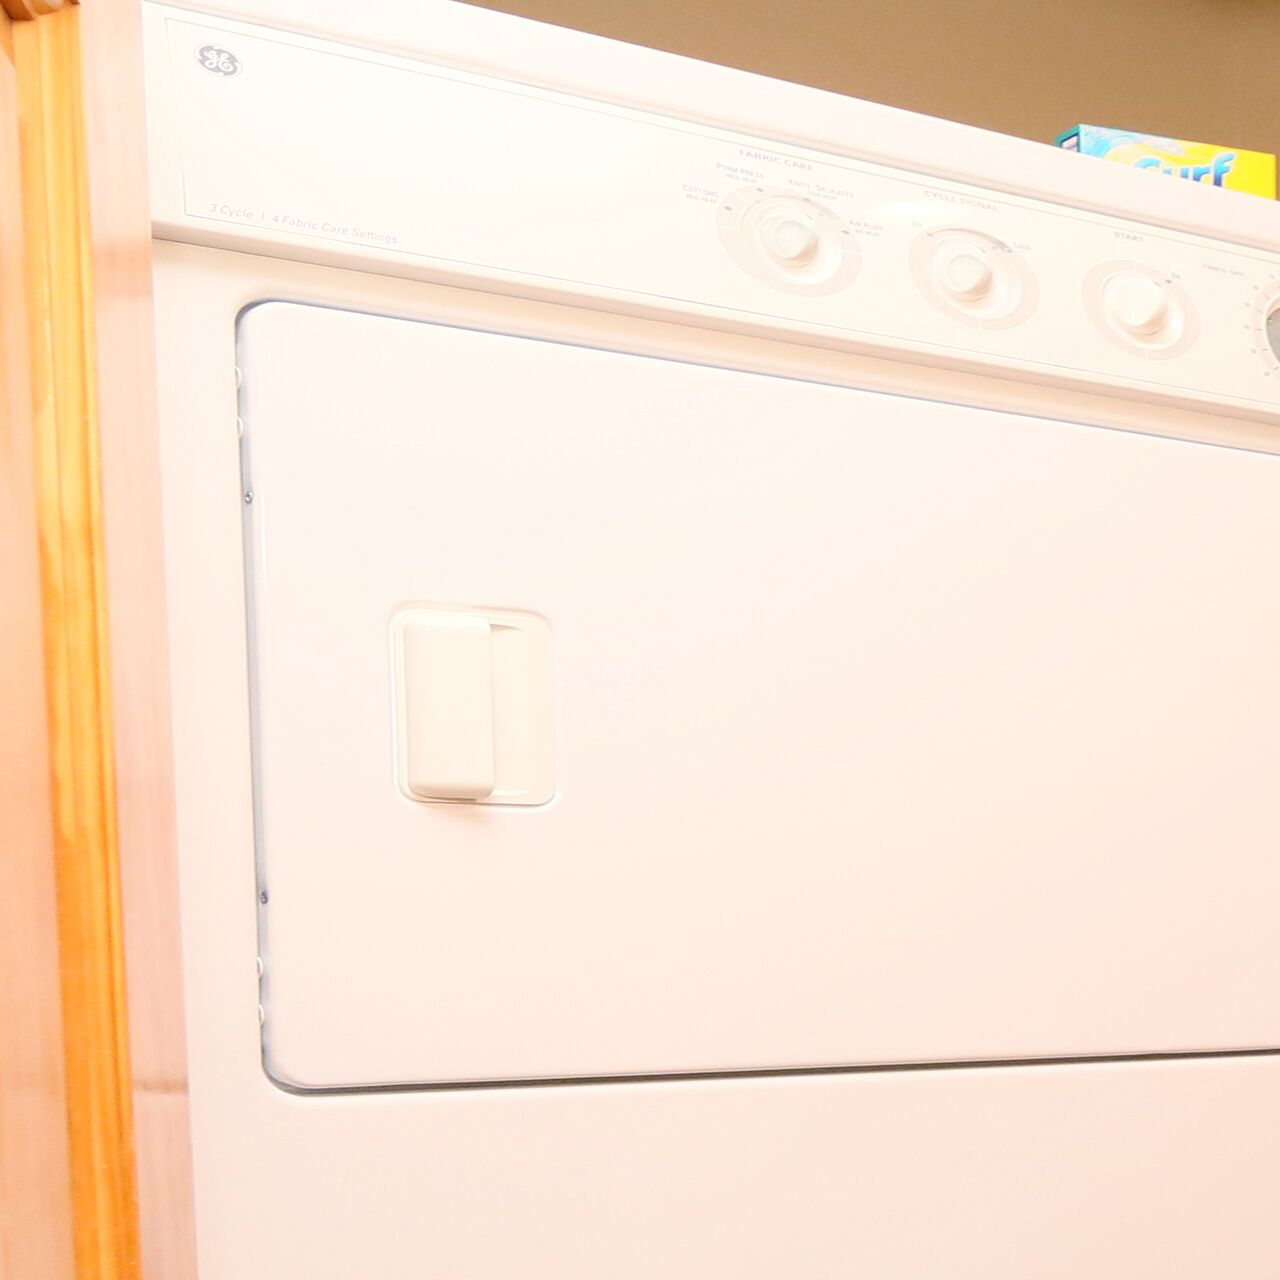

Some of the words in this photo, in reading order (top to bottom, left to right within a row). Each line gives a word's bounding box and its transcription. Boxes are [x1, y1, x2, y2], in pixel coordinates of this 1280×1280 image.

[784, 158, 813, 172] CARE
[924, 190, 959, 204] CYCLE
[960, 198, 1000, 212] SIGNAL
[220, 204, 254, 220] Cycle
[281, 215, 319, 231] Fabric
[321, 222, 349, 236] Care
[351, 227, 398, 244] Settings
